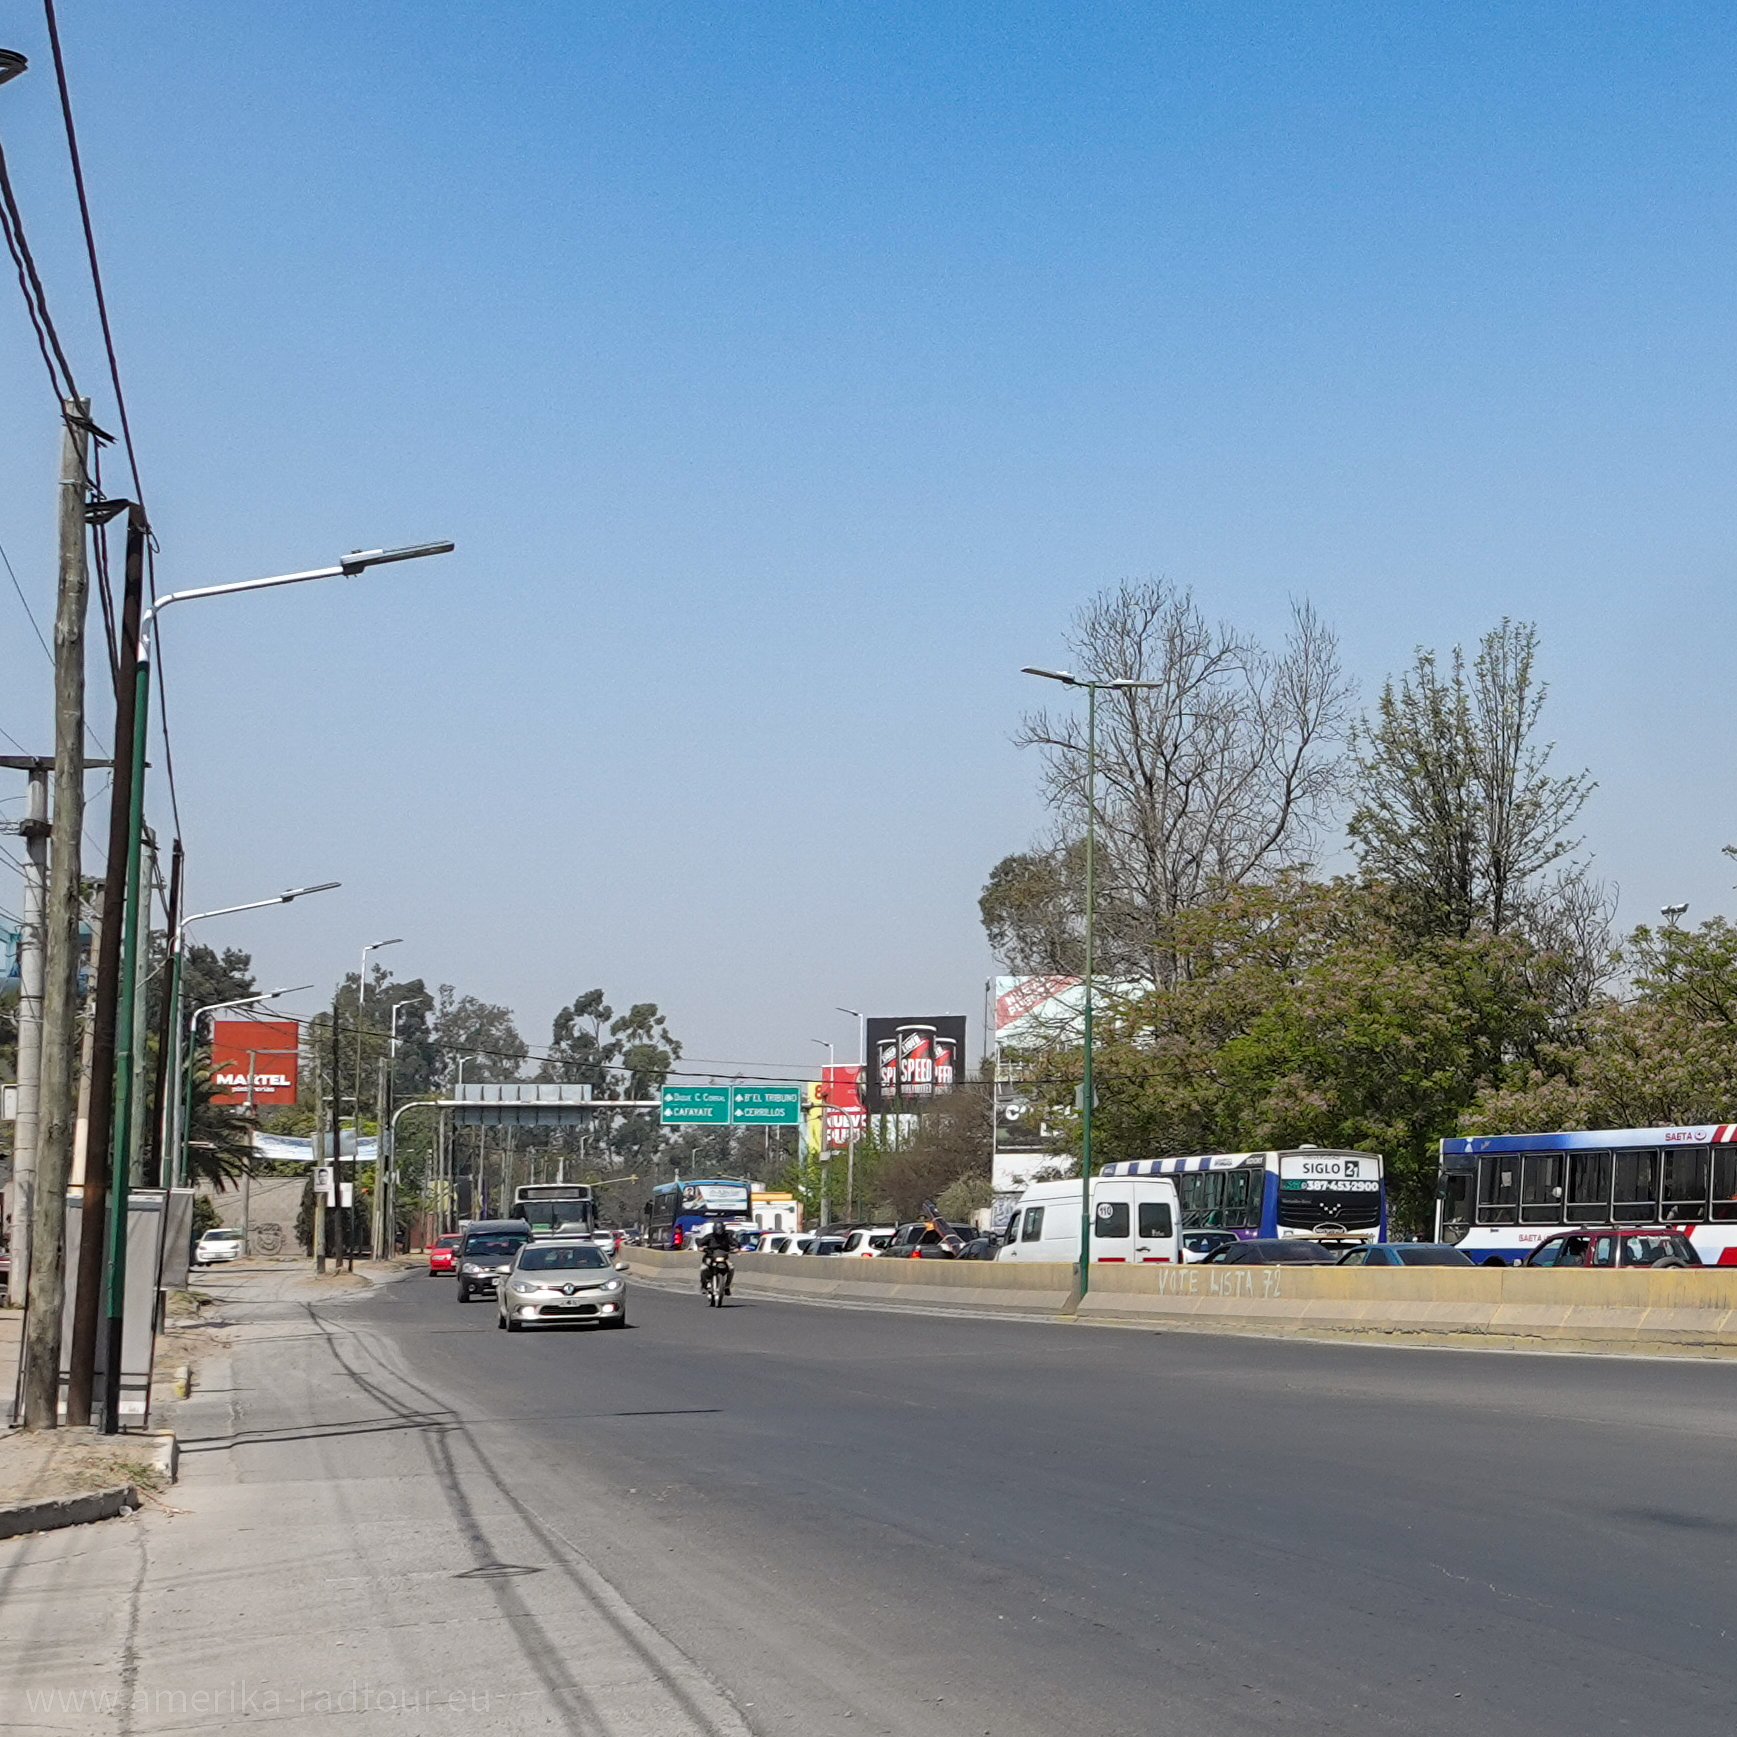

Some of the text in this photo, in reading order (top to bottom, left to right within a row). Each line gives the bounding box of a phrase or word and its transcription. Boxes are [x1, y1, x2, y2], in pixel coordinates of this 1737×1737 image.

[900, 1058, 932, 1082] SPEED
[673, 1107, 713, 1117] CAFAYATE
[744, 1107, 786, 1117] CERRILLOS
[1665, 1131, 1693, 1142] SAETA
[1302, 1162, 1360, 1178] SIGLO 21
[1306, 1180, 1379, 1191] 387-453-2900
[1099, 1205, 1112, 1216] 110
[1518, 1234, 1542, 1242] SAETA
[1159, 1268, 1281, 1299] VOTE LISTA 72
